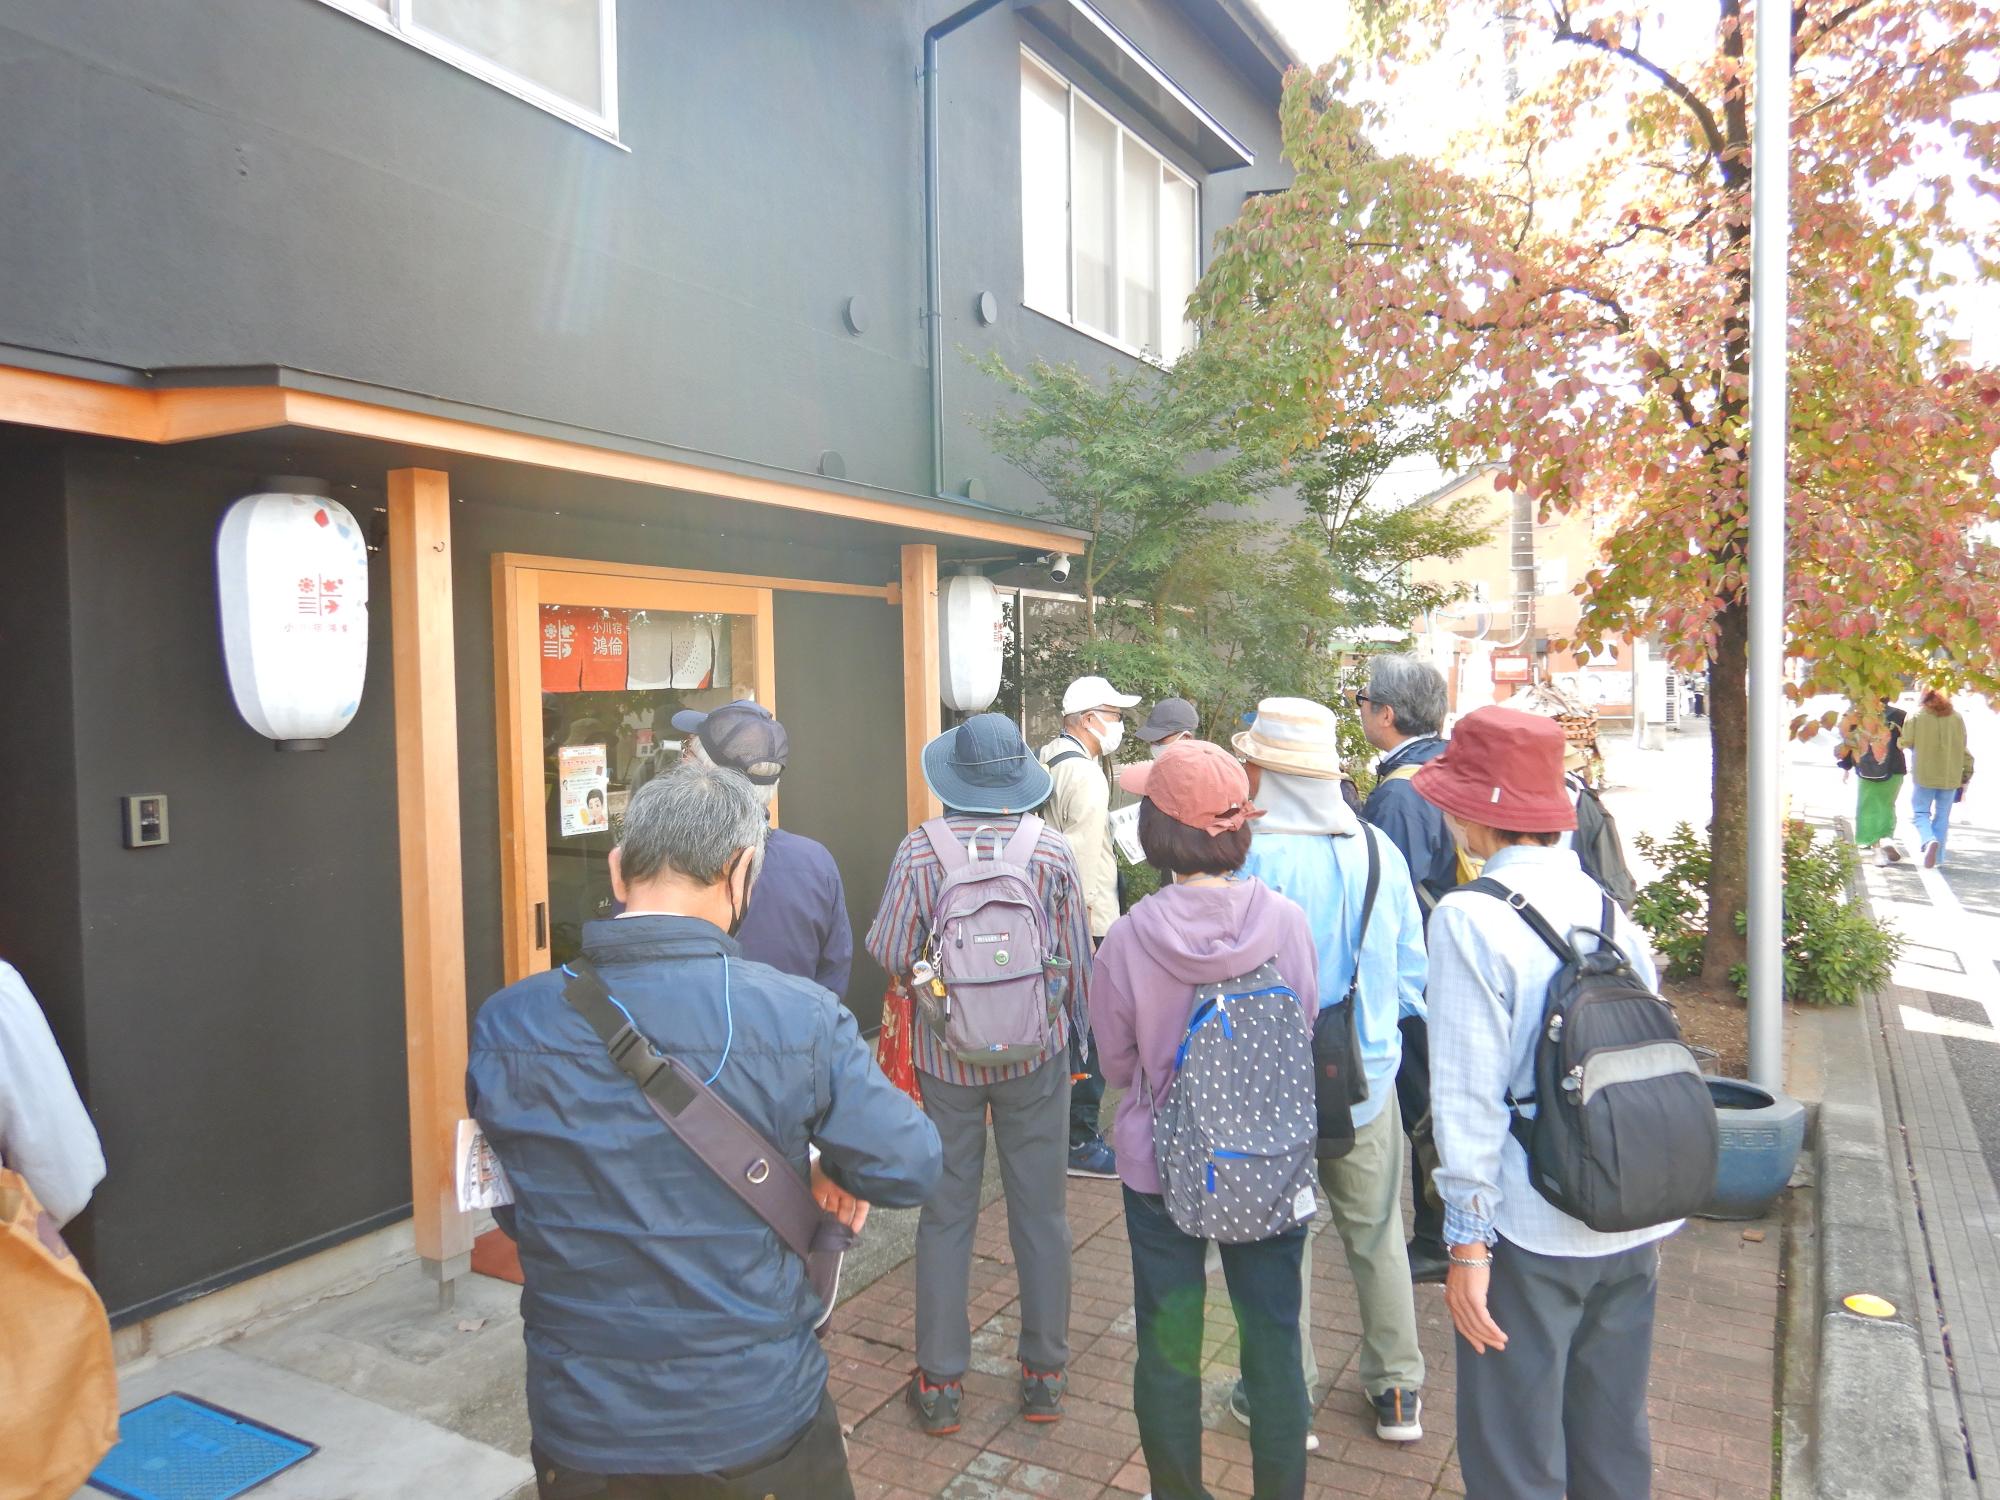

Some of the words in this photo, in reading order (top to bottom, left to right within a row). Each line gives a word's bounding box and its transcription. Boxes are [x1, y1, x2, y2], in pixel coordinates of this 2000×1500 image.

[592, 622, 622, 634] 小川宿
[593, 636, 623, 656] 鴻倫
